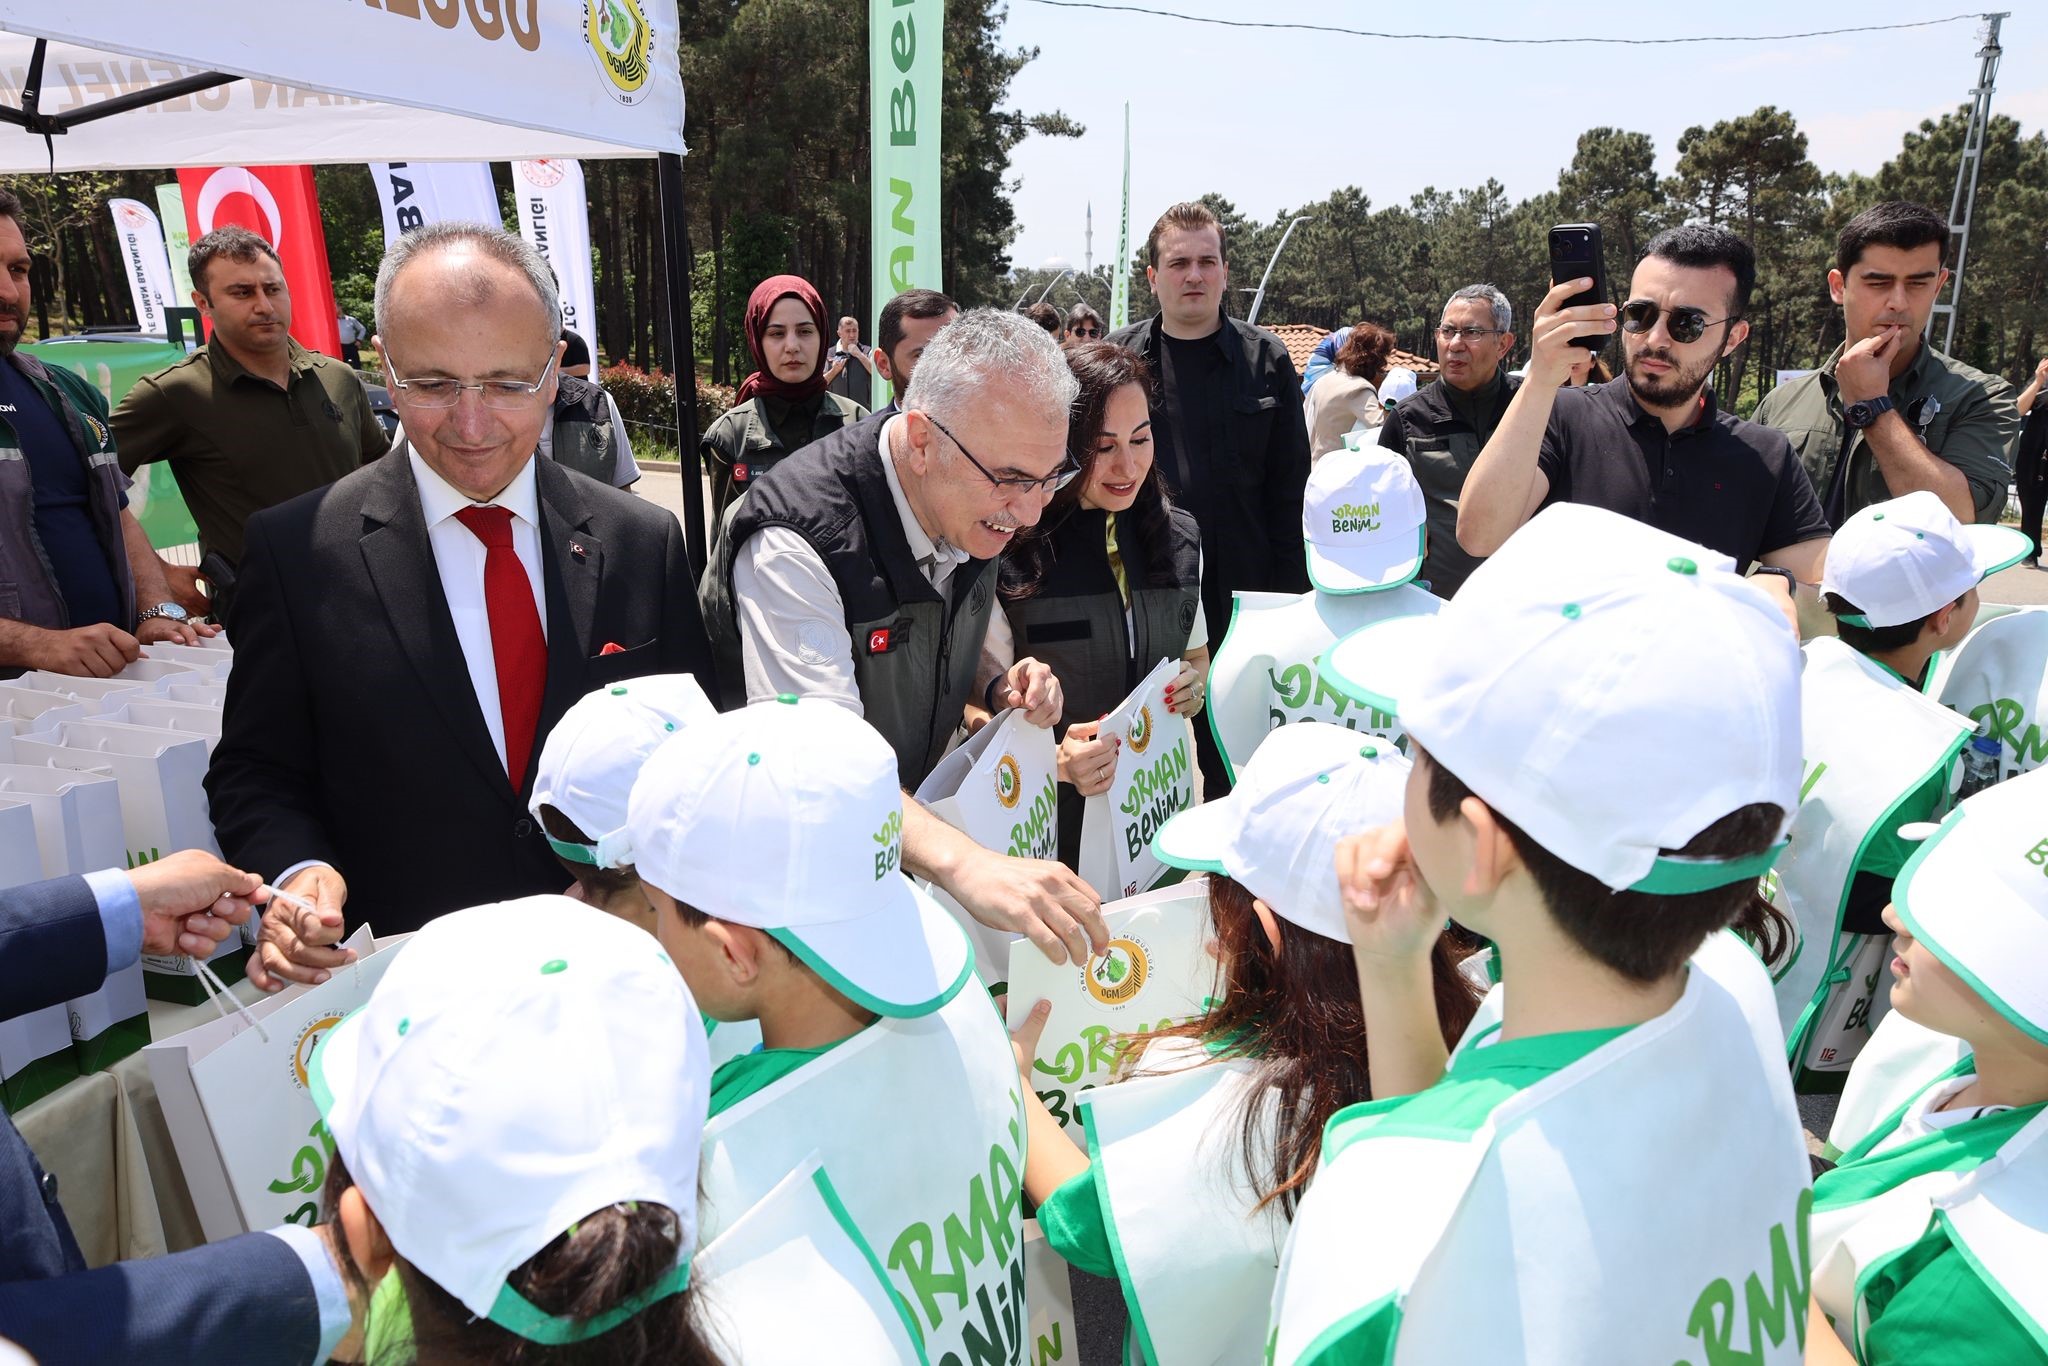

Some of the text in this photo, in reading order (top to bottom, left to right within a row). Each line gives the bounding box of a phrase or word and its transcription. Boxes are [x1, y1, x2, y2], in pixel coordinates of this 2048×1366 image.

[606, 51, 628, 80] OGM
[619, 94, 632, 103] 1839
[889, 0, 916, 296] AN Be
[1331, 502, 1380, 519] ORMAN
[1120, 738, 1187, 817] ORMAN
[1101, 988, 1120, 999] OGM
[1820, 1048, 1838, 1060] 112
